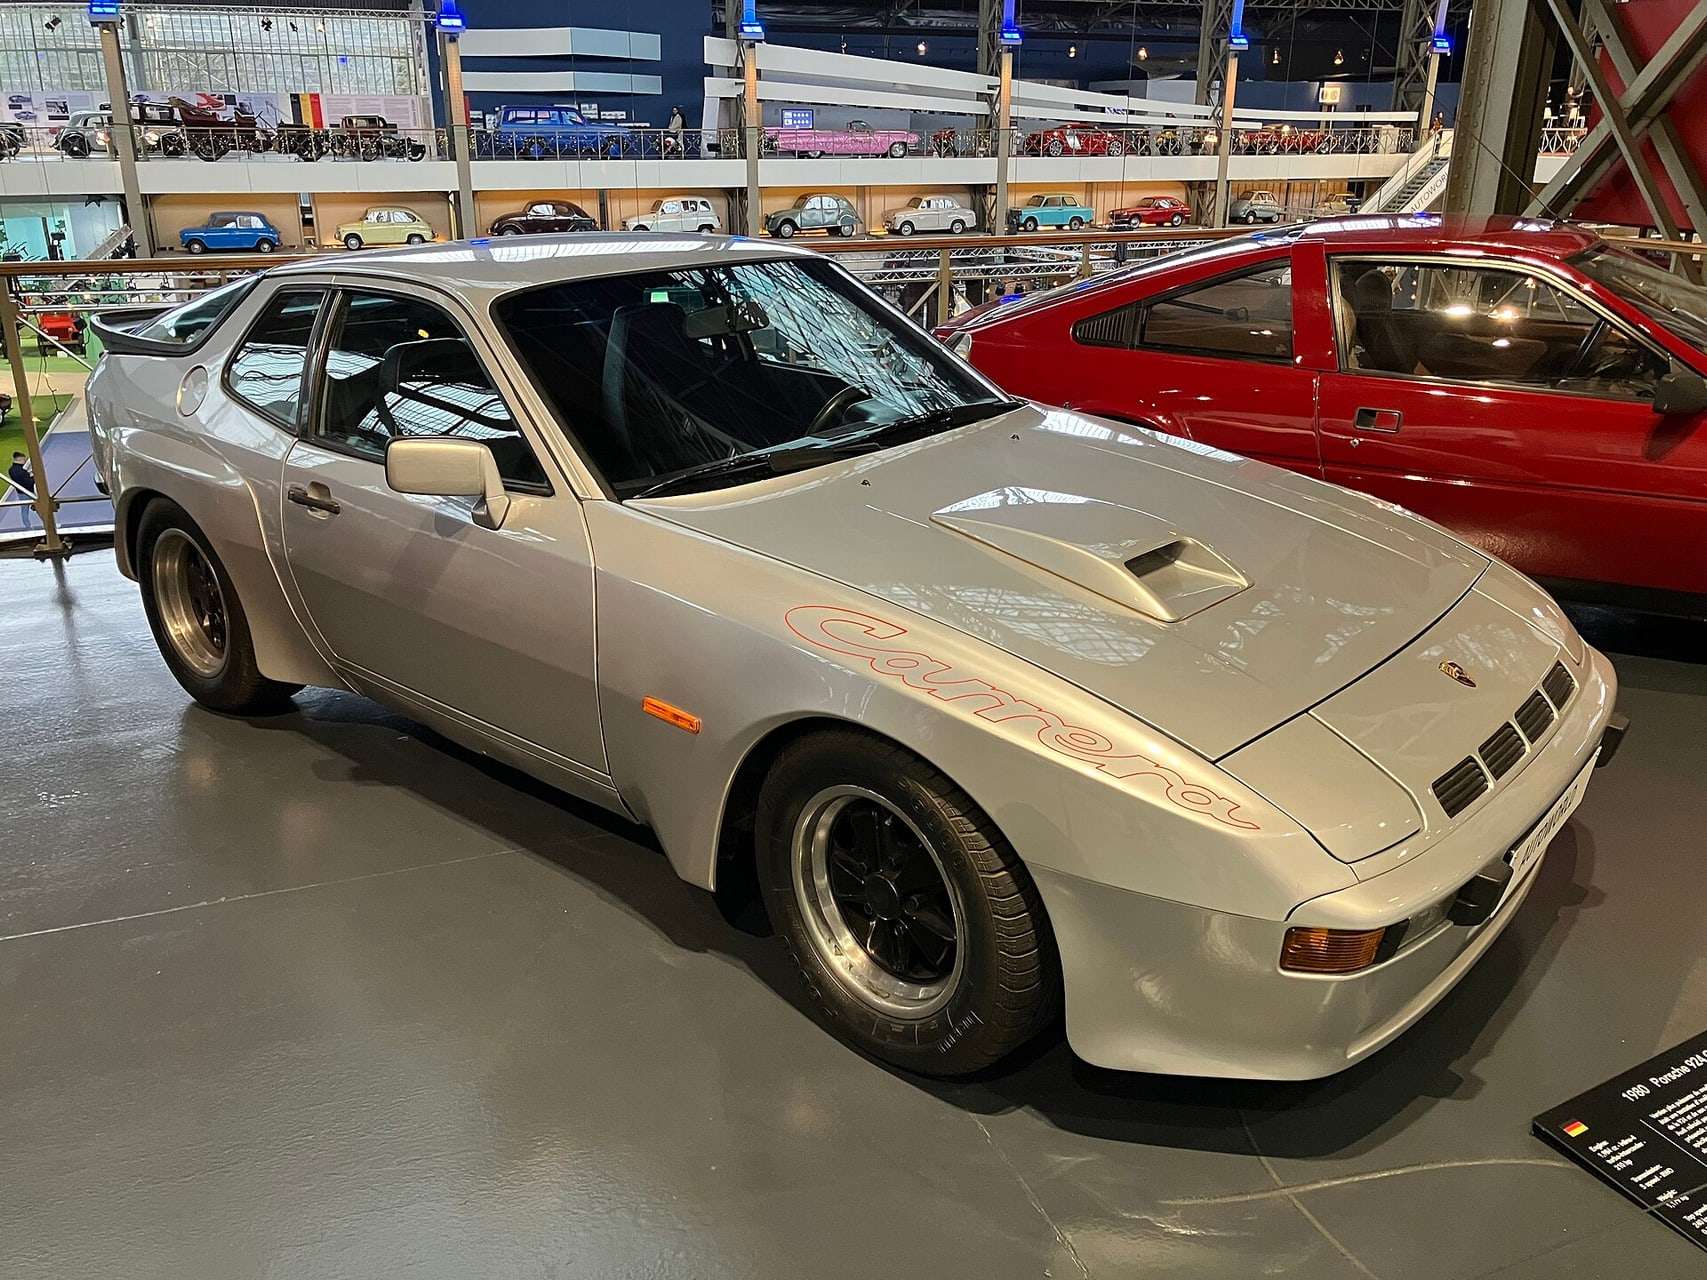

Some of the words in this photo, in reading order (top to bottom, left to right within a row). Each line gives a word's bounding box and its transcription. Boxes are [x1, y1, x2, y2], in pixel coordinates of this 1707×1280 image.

[784, 605, 1261, 830] Carrera
[1621, 1084, 1650, 1102] 1980
[1649, 1064, 1691, 1088] Porsche
[1684, 1054, 1707, 1069] 924
